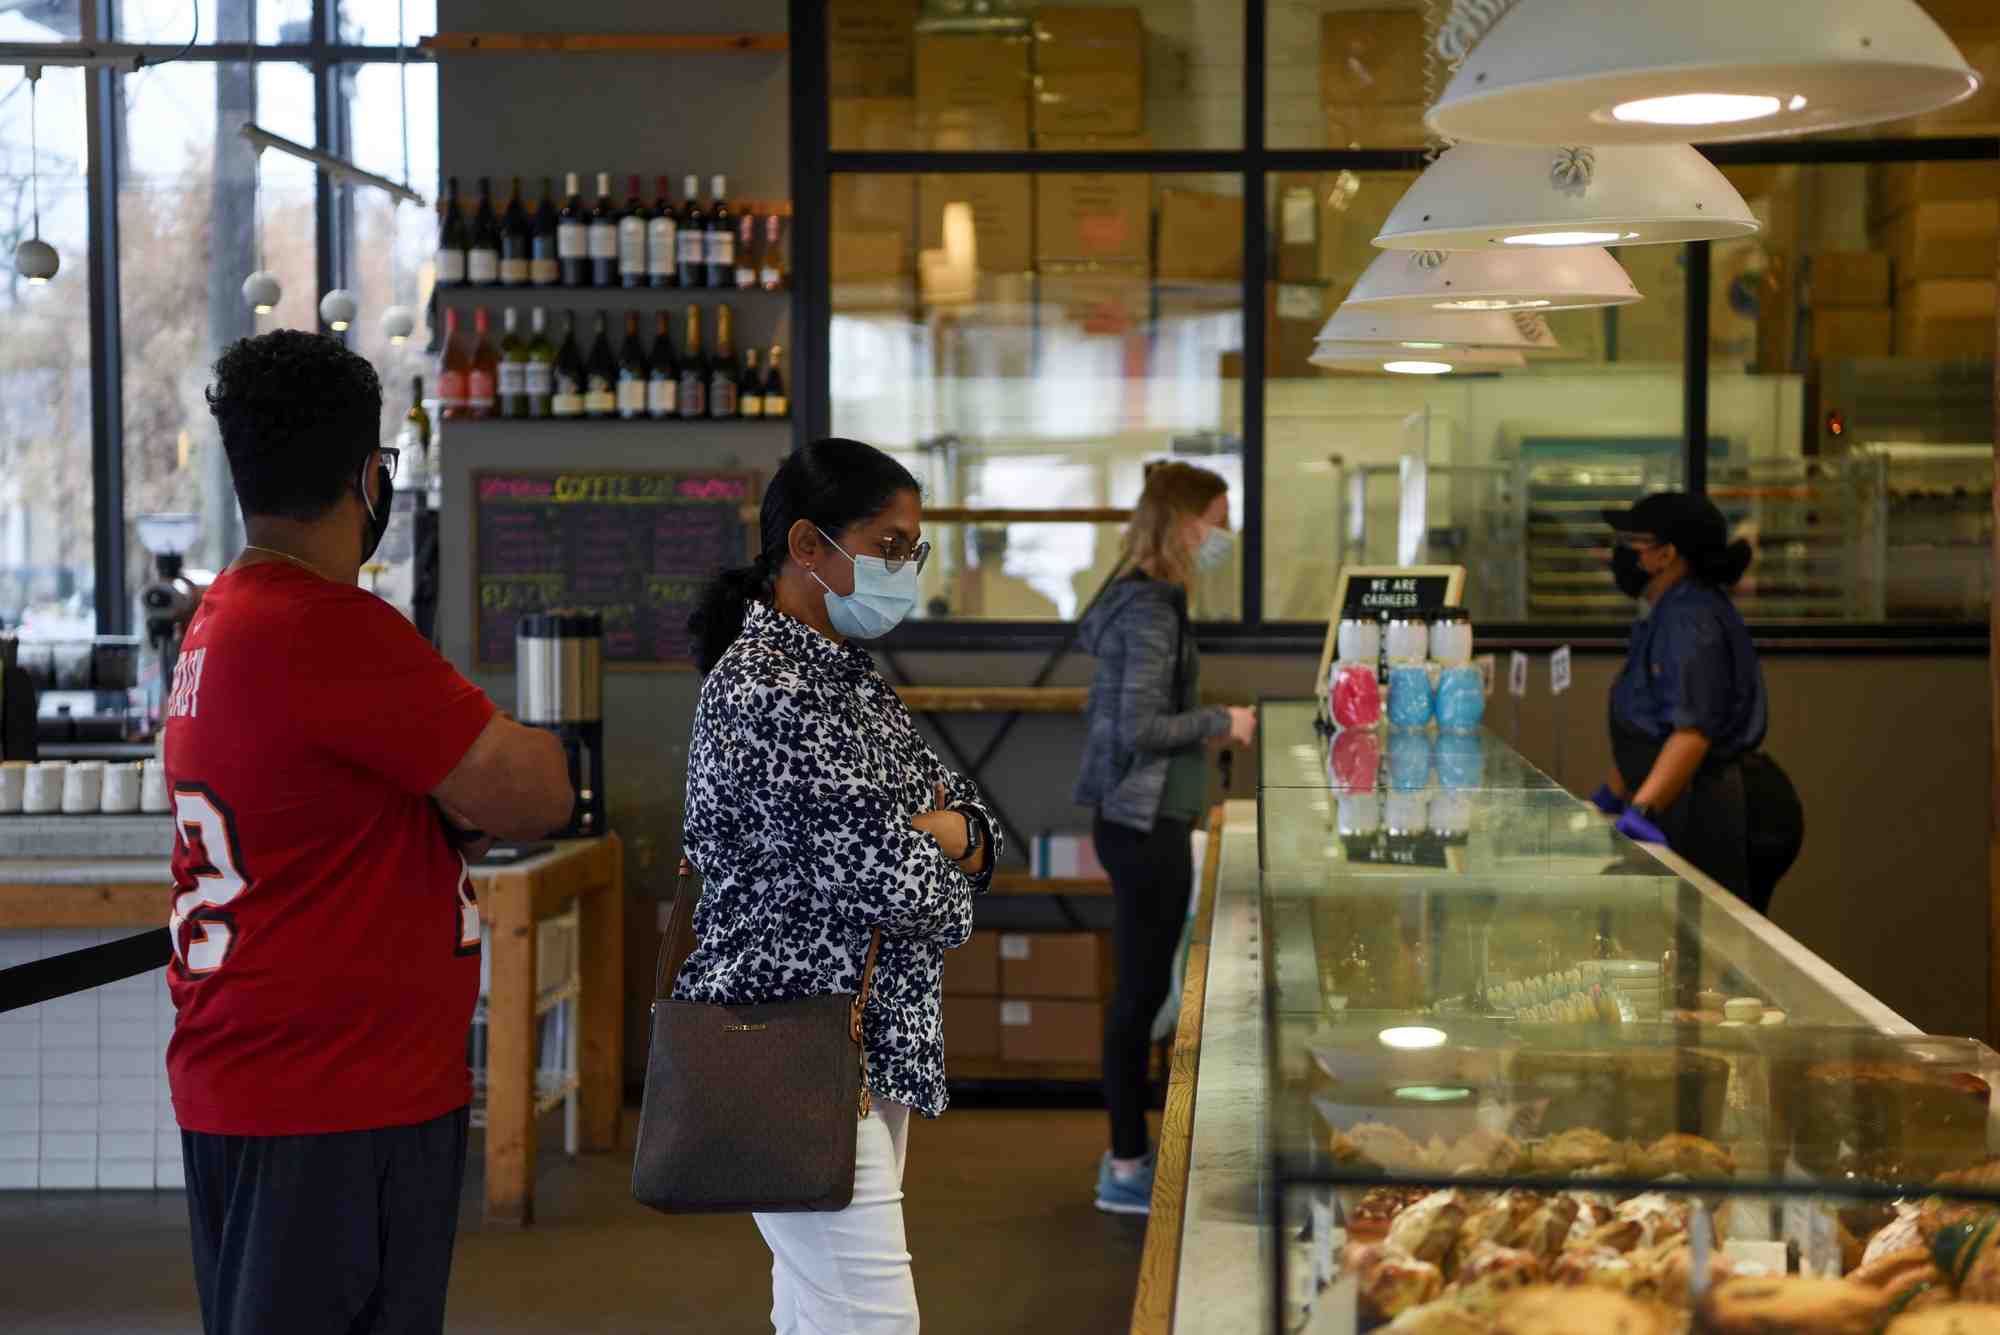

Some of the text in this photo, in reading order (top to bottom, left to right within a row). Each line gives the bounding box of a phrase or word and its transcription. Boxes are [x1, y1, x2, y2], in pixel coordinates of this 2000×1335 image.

[1371, 579, 1417, 592] WE ARE
[1361, 593, 1418, 608] CASHLESS
